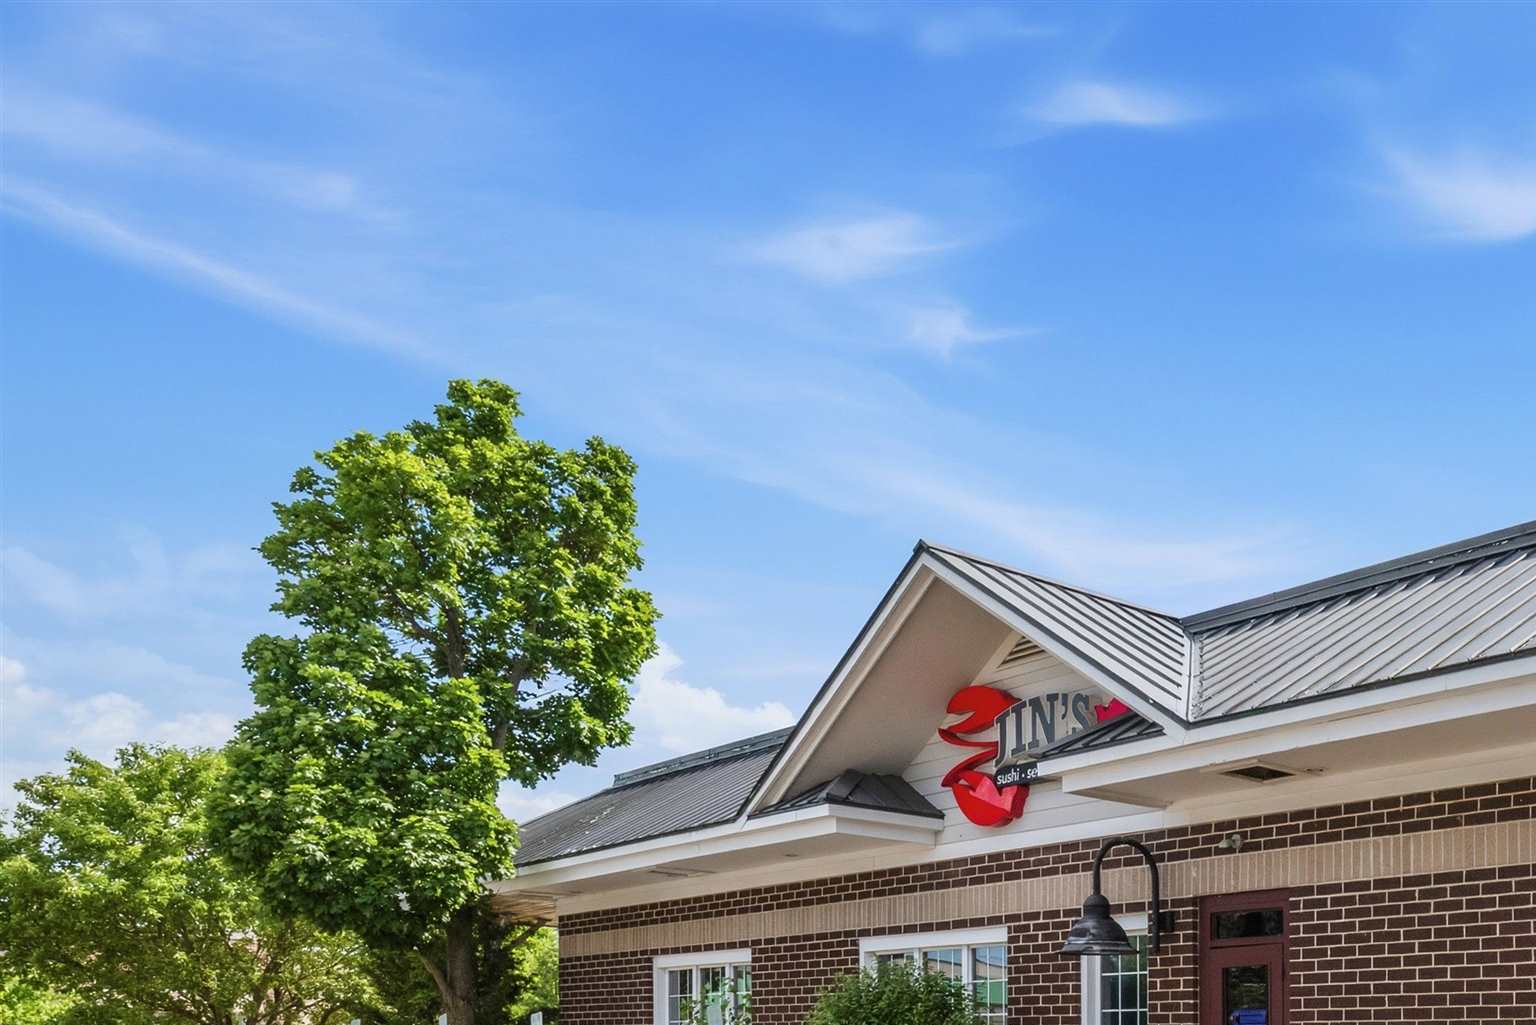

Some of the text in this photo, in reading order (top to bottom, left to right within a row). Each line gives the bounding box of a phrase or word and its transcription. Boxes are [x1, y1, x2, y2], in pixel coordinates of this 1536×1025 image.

[994, 692, 1090, 768] JIN'S
[996, 766, 1039, 785] sushi se
